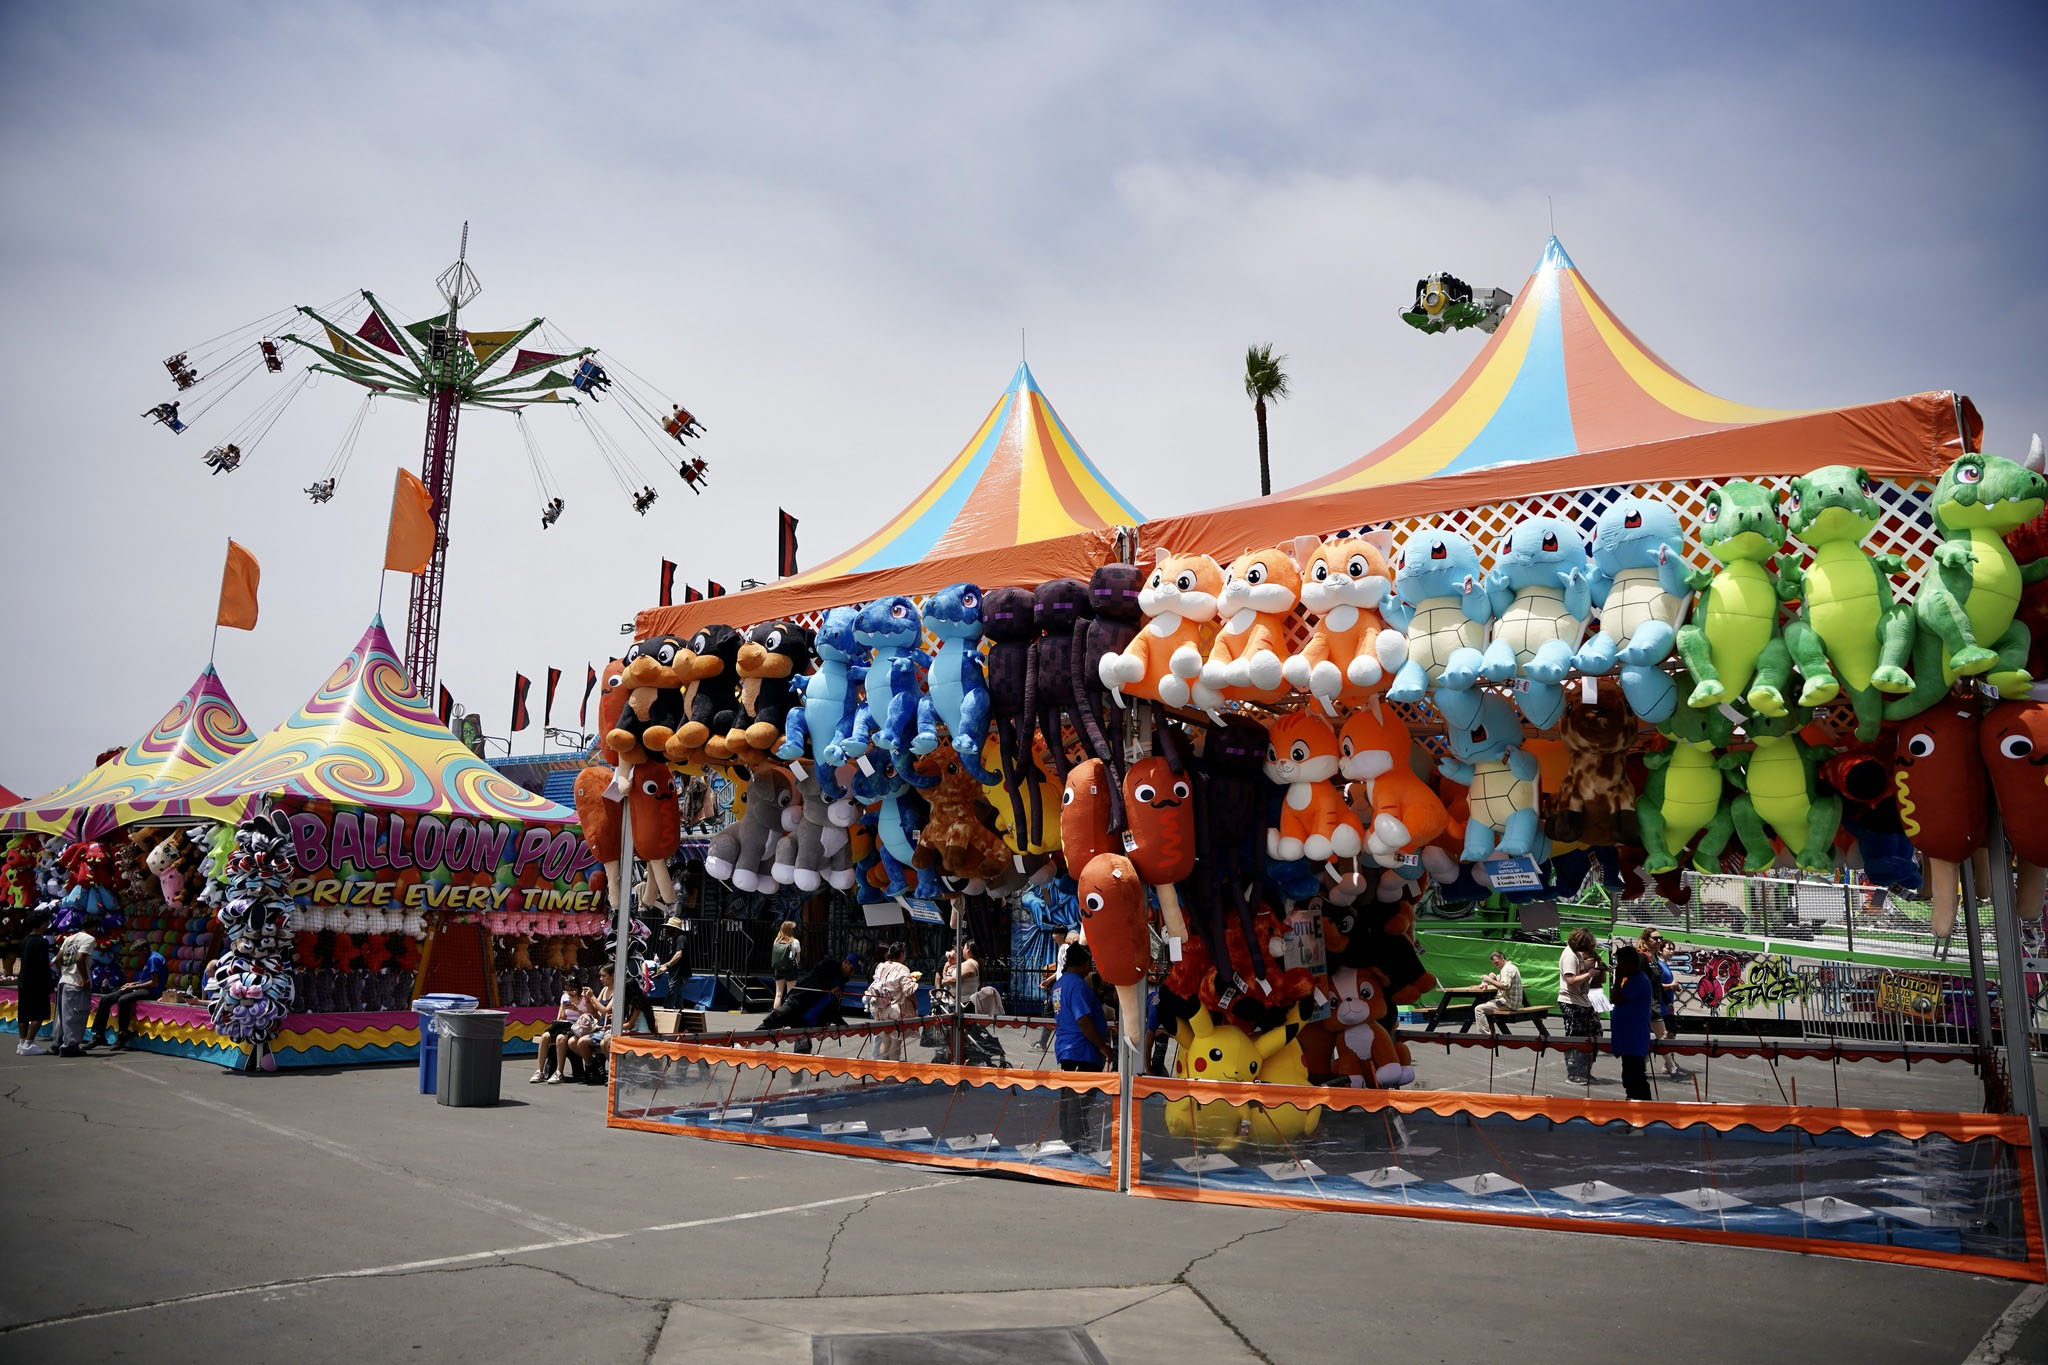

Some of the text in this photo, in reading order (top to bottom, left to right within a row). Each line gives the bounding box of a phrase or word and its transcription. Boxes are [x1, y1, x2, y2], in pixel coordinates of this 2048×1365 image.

[290, 812, 601, 883] BALLOON POP
[289, 878, 602, 913] PRIZE EVERY TIME!
[1291, 916, 1322, 938] OTTLE
[1750, 957, 1783, 985] ON
[1883, 1000, 1911, 1011] ZOE
